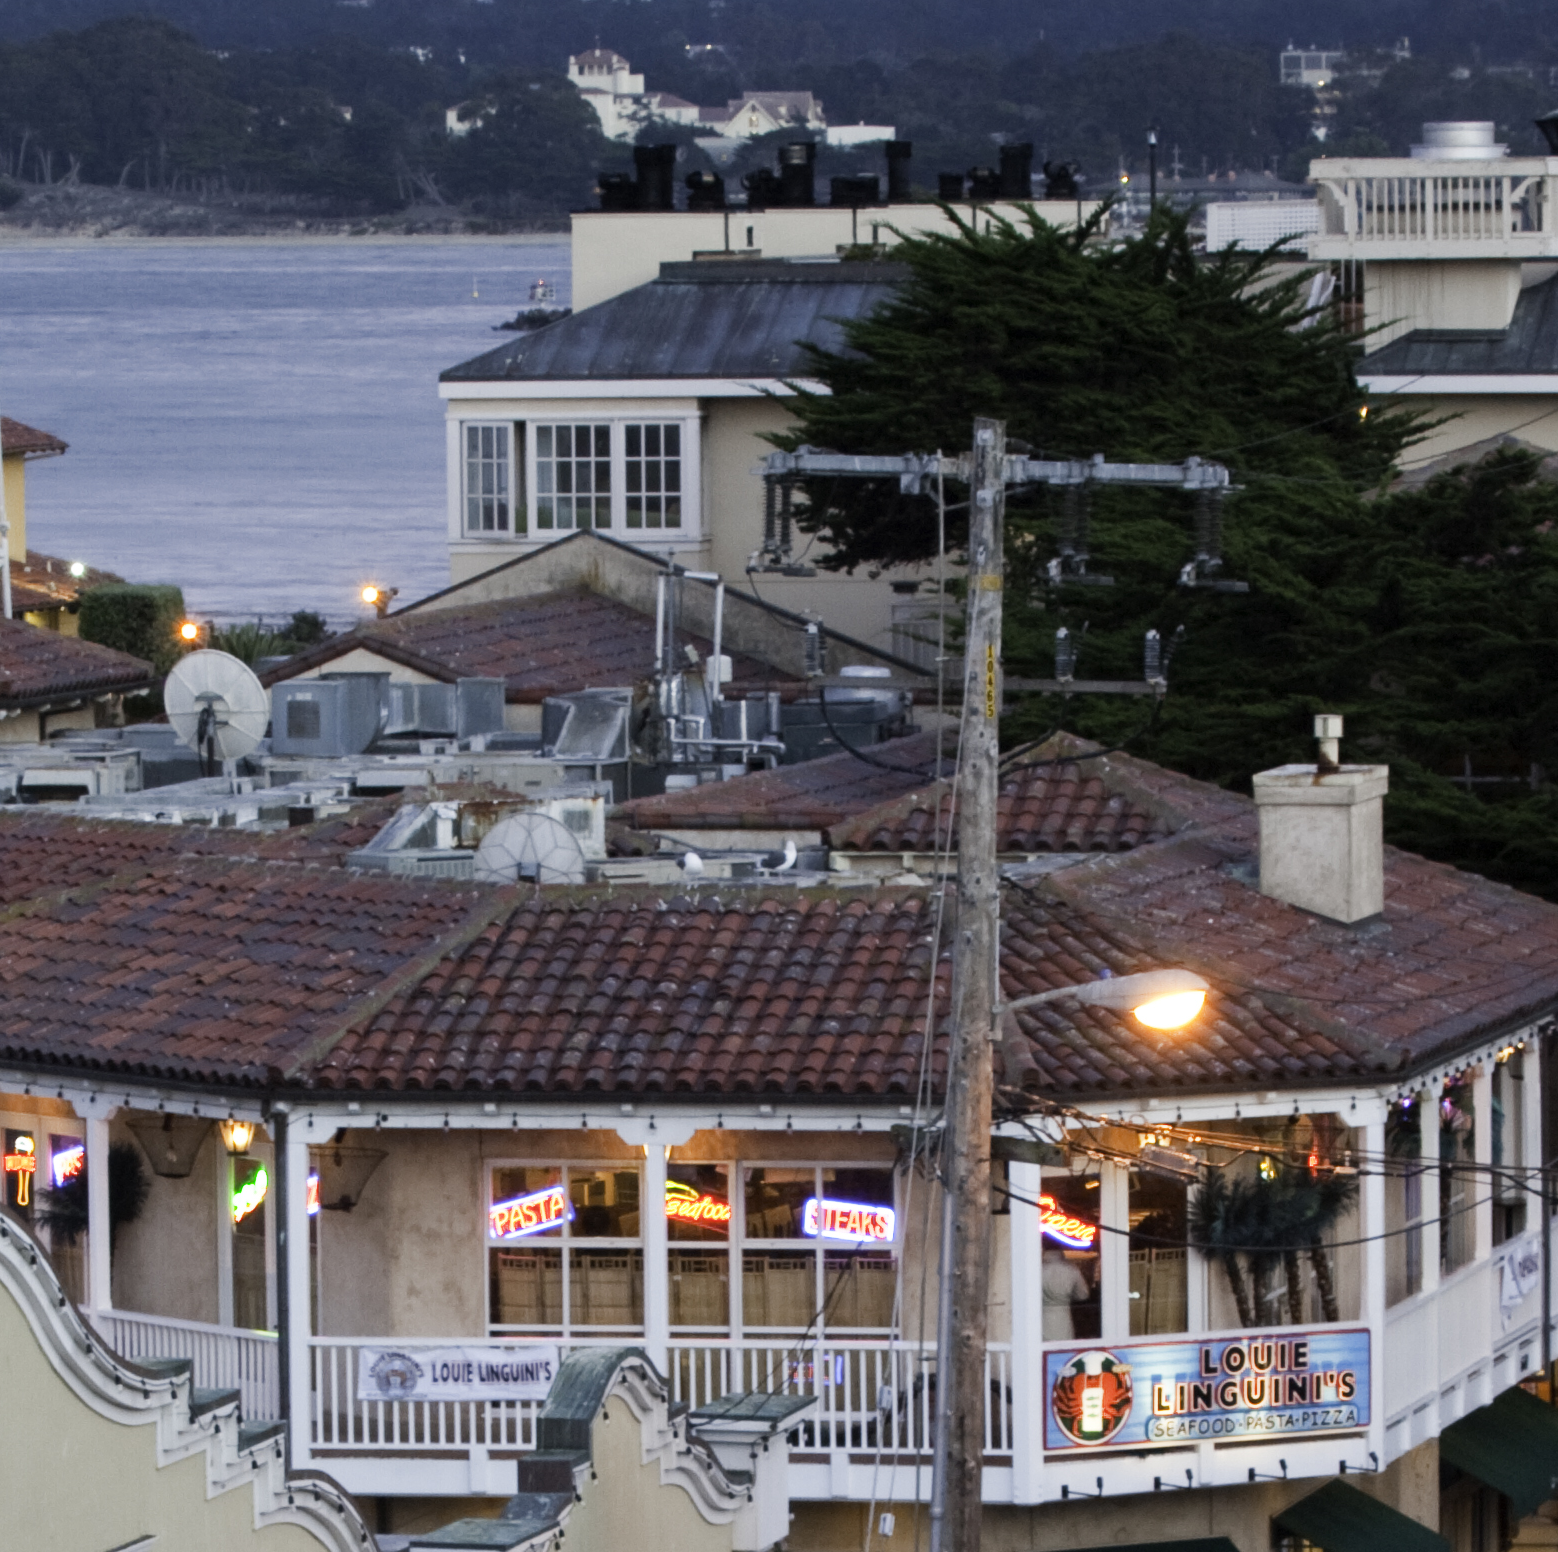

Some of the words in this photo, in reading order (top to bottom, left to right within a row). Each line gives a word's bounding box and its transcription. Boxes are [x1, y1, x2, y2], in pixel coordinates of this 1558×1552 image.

[493, 1192, 564, 1236] PASTA
[809, 1206, 889, 1240] STEAKS
[431, 1361, 474, 1383] LOUIE
[478, 1360, 552, 1383] LINGUINI'S
[1201, 1339, 1309, 1378] LOUIE
[1152, 1371, 1356, 1416] LINGUINI'S
[1154, 1416, 1235, 1438] SEAFOOD
[1246, 1413, 1293, 1432] PASTA
[1301, 1409, 1356, 1427] PIZZA
